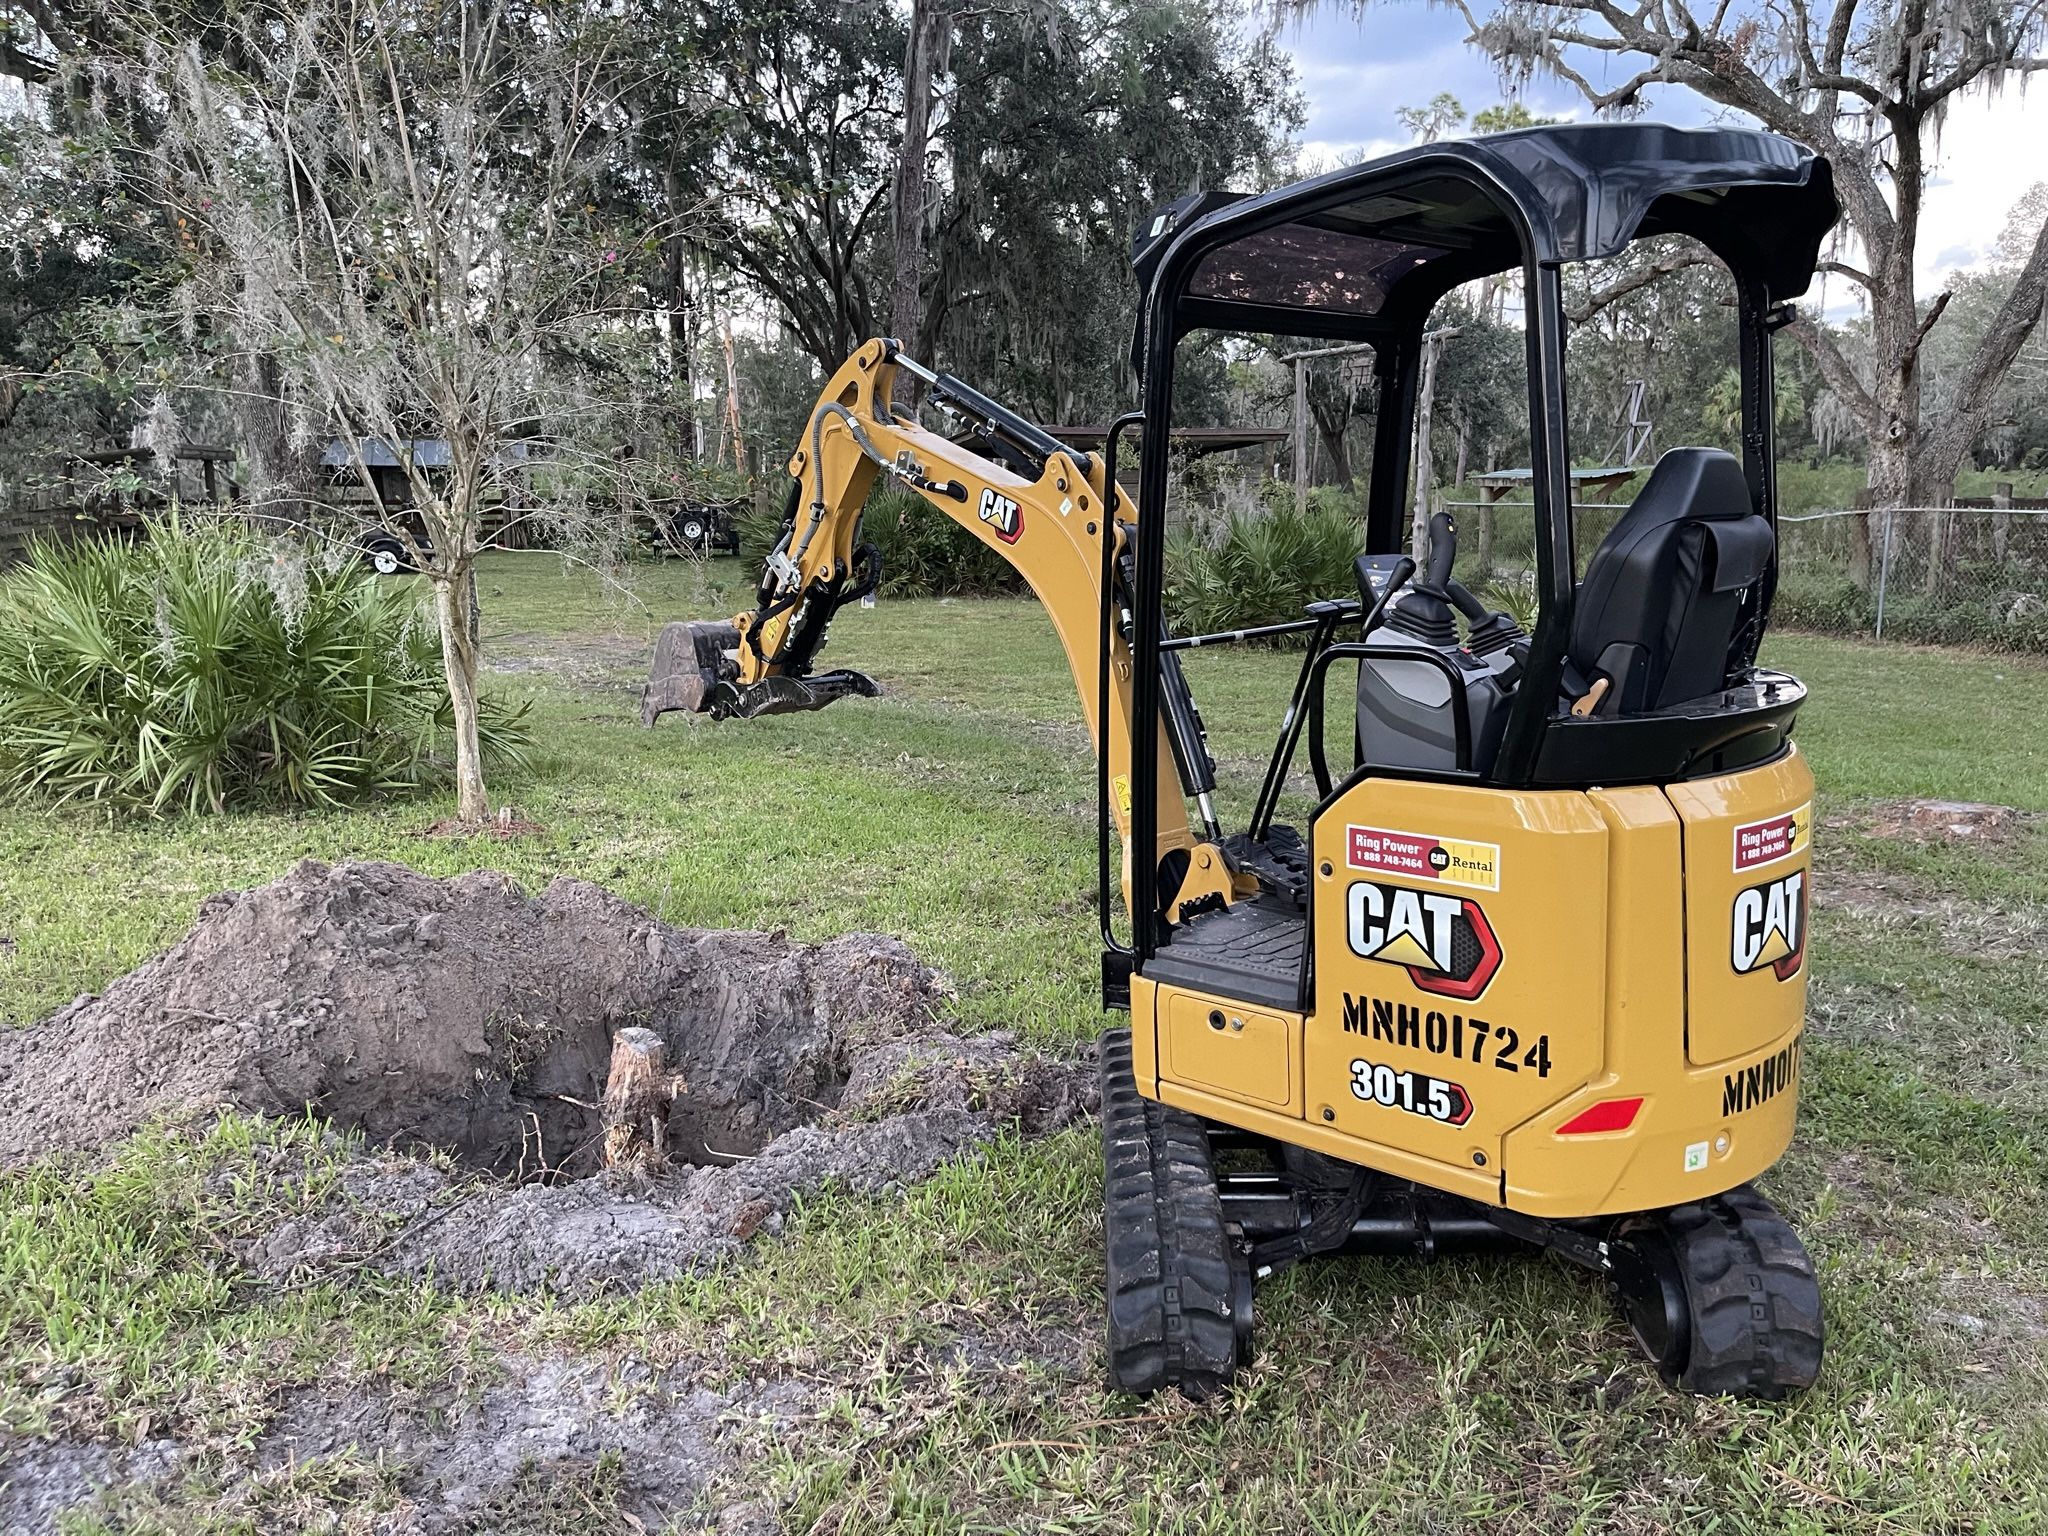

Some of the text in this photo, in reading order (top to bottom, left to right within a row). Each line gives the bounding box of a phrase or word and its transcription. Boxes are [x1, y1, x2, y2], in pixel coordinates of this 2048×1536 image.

[981, 489, 1017, 532] CAT
[1355, 834, 1420, 855] Ring Power
[1742, 833, 1760, 847] Ring
[1761, 827, 1785, 842] Power
[1356, 851, 1423, 869] 1 888 748-7464
[1430, 853, 1447, 865] CAT
[1452, 857, 1493, 872] Rental
[1348, 882, 1462, 972] CAT
[1733, 873, 1801, 971] CAT
[1351, 1060, 1451, 1120] 301.5
